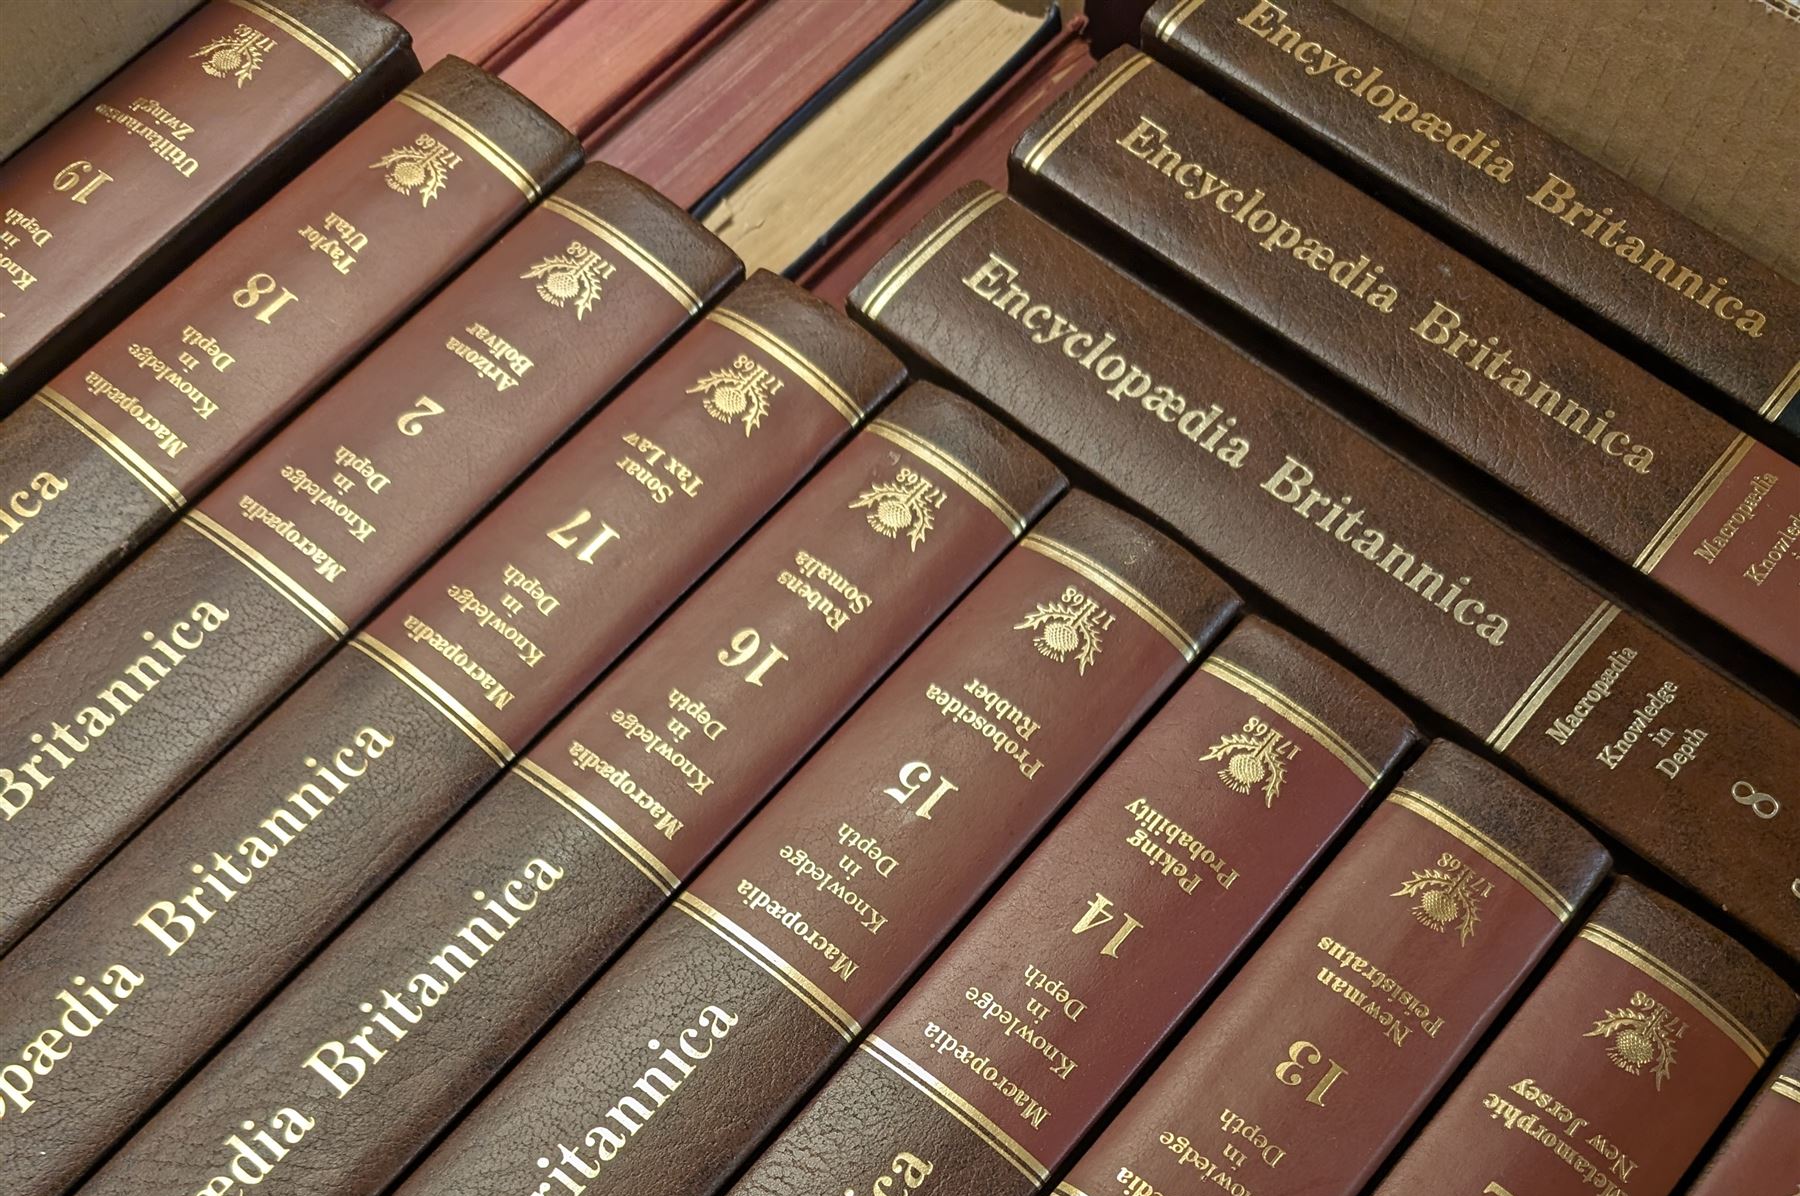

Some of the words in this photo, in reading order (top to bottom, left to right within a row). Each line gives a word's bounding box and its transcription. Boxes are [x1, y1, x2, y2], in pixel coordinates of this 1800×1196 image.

[129, 97, 195, 141] Zwingli
[52, 159, 115, 205] 19
[1236, 0, 1517, 185] Encyclopædia
[1526, 172, 1767, 339] Britannica
[4, 208, 54, 248] Depth
[298, 224, 359, 276] Taylor
[323, 211, 370, 255] Utah
[232, 272, 299, 325] 18
[1114, 114, 1400, 315] Encyclopædia
[1409, 301, 1656, 477] Britannica
[177, 350, 201, 375] in
[182, 324, 236, 374] Depth
[444, 335, 520, 393] Arizona
[127, 343, 220, 421] Knowledge
[396, 394, 446, 437] 2
[334, 444, 392, 495] Depth
[622, 432, 666, 467] Law
[664, 456, 704, 498] Tax
[962, 253, 1252, 471] Encyclopædia
[1260, 456, 1508, 647] Britannica
[280, 464, 377, 544] Knowledge
[332, 470, 356, 497] in
[616, 456, 675, 505] Sonar
[238, 494, 347, 584] Macropædia
[546, 509, 621, 565] 17
[500, 592, 525, 618] in
[503, 563, 561, 617] Depth
[776, 569, 852, 634] Rubens
[793, 550, 873, 615] Somalia
[446, 583, 547, 668] Knowledge
[402, 614, 515, 711] Macropædia
[717, 627, 789, 688] 16
[0, 599, 230, 821] Britannica
[666, 687, 728, 743] Depth
[963, 676, 1042, 742] Rubber
[1545, 645, 1638, 746] Macropædia
[1596, 679, 1679, 770] Knowledge
[609, 707, 714, 797] Knowledge
[666, 718, 692, 745] in
[924, 682, 1045, 781] Proboscidea
[1653, 726, 1675, 749] in
[1656, 727, 1709, 780] Depth
[568, 739, 685, 841] Macropædia
[883, 760, 959, 822] 15
[1731, 780, 1780, 819] 8
[132, 723, 395, 956] Britannica
[837, 853, 863, 881] in
[838, 823, 900, 880] Depth
[1124, 798, 1241, 891] Probability
[1126, 828, 1203, 896] Peking
[779, 844, 888, 935] Knowledge
[736, 879, 860, 983] Macropædia
[1071, 892, 1145, 959] 14
[301, 853, 564, 1100] Britannica
[1024, 964, 1088, 1023] Depth
[1316, 936, 1446, 1039] Peisistratus
[965, 986, 1079, 1081] Knowledge
[1026, 997, 1051, 1025] in
[1316, 966, 1413, 1049] Newman
[923, 1021, 1051, 1131] Macropædia
[1273, 1039, 1350, 1108] 13
[1507, 1077, 1589, 1137] Jersey
[1219, 1108, 1287, 1169] Depth
[1222, 1143, 1248, 1171] in
[1585, 1134, 1640, 1184] New
